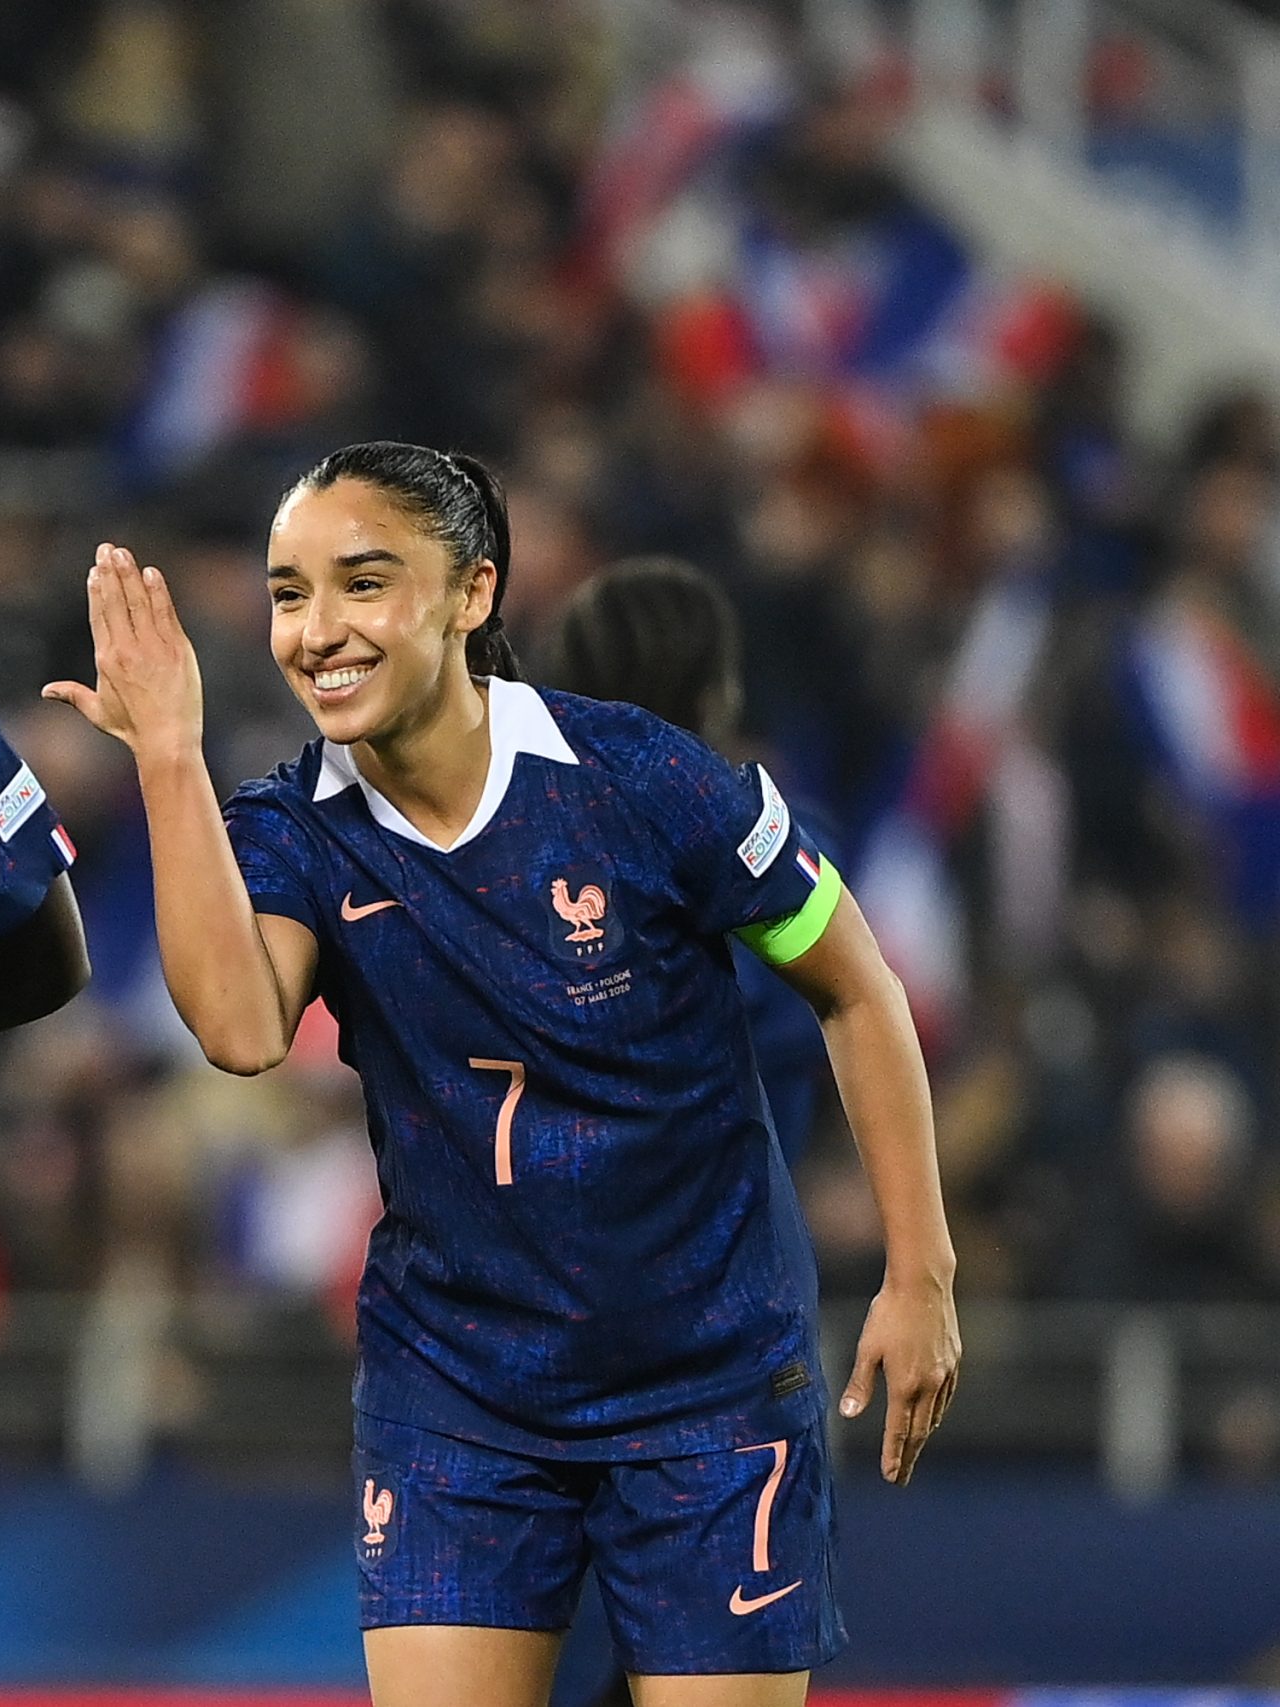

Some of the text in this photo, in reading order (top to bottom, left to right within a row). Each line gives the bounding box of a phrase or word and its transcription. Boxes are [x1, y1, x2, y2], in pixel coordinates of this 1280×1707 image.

[741, 832, 760, 856] UEFA
[566, 982, 593, 995] FRANCE
[600, 969, 632, 988] POLOGNE
[574, 983, 631, 1006] 07 MARS 2026
[469, 1057, 526, 1186] 7
[734, 1440, 787, 1572] 7
